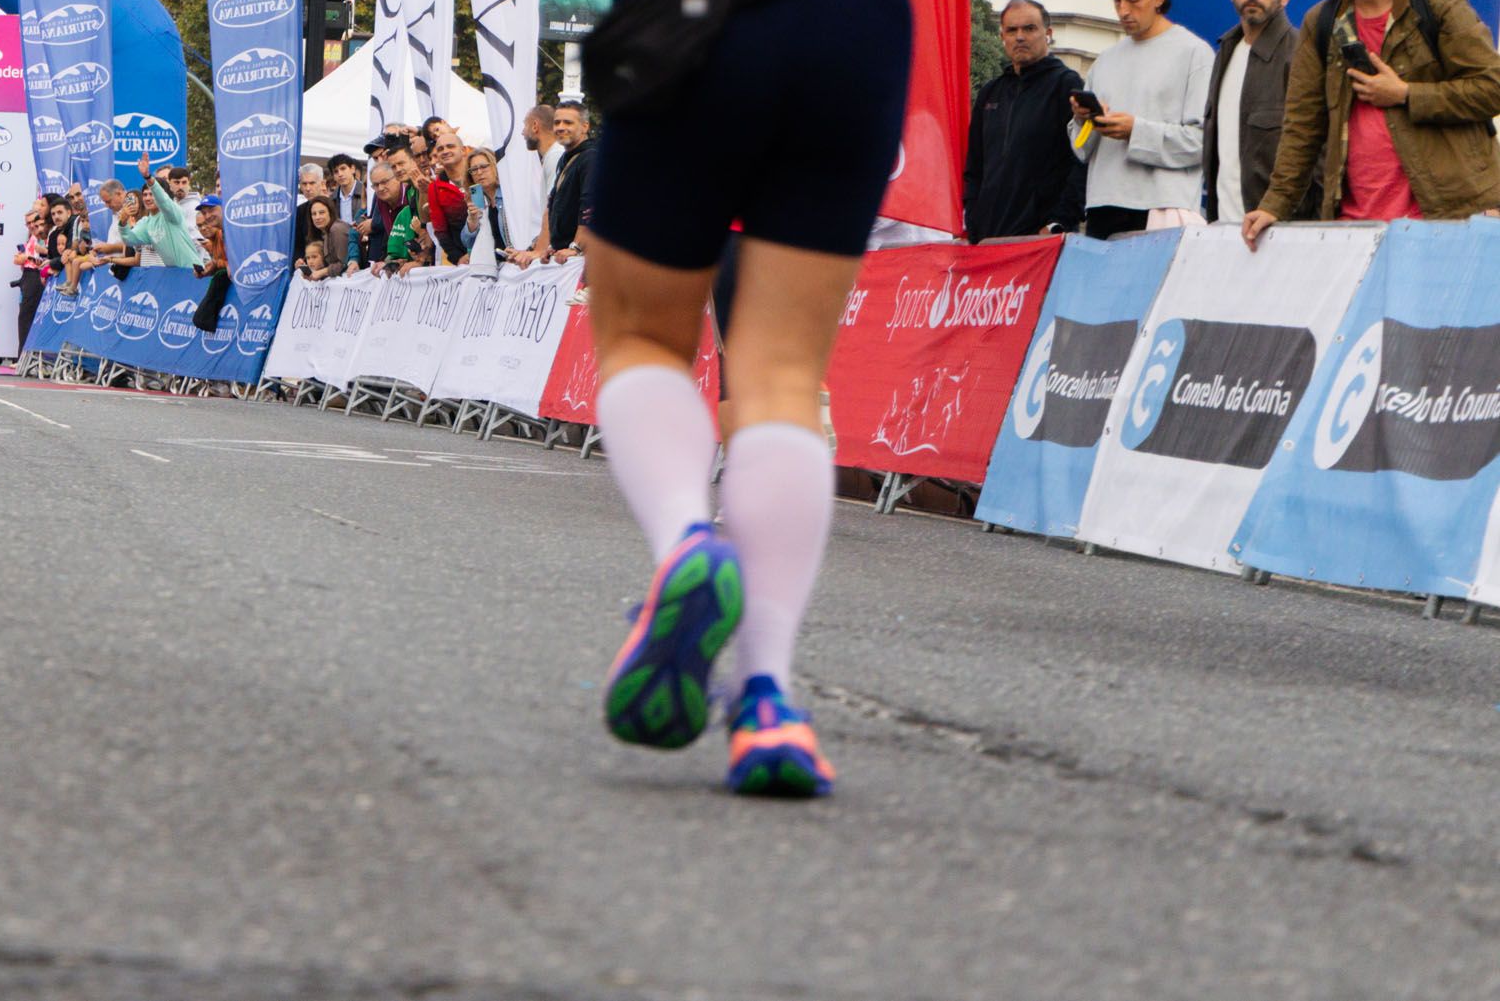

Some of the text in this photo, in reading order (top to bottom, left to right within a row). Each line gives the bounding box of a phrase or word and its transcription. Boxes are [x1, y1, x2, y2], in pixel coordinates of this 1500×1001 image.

[114, 138, 175, 152] TURIANA
[886, 275, 935, 343] Sports
[944, 275, 1030, 327] Santander
[1172, 374, 1227, 409] Concello
[1224, 377, 1245, 411] da
[1430, 385, 1453, 424] da
